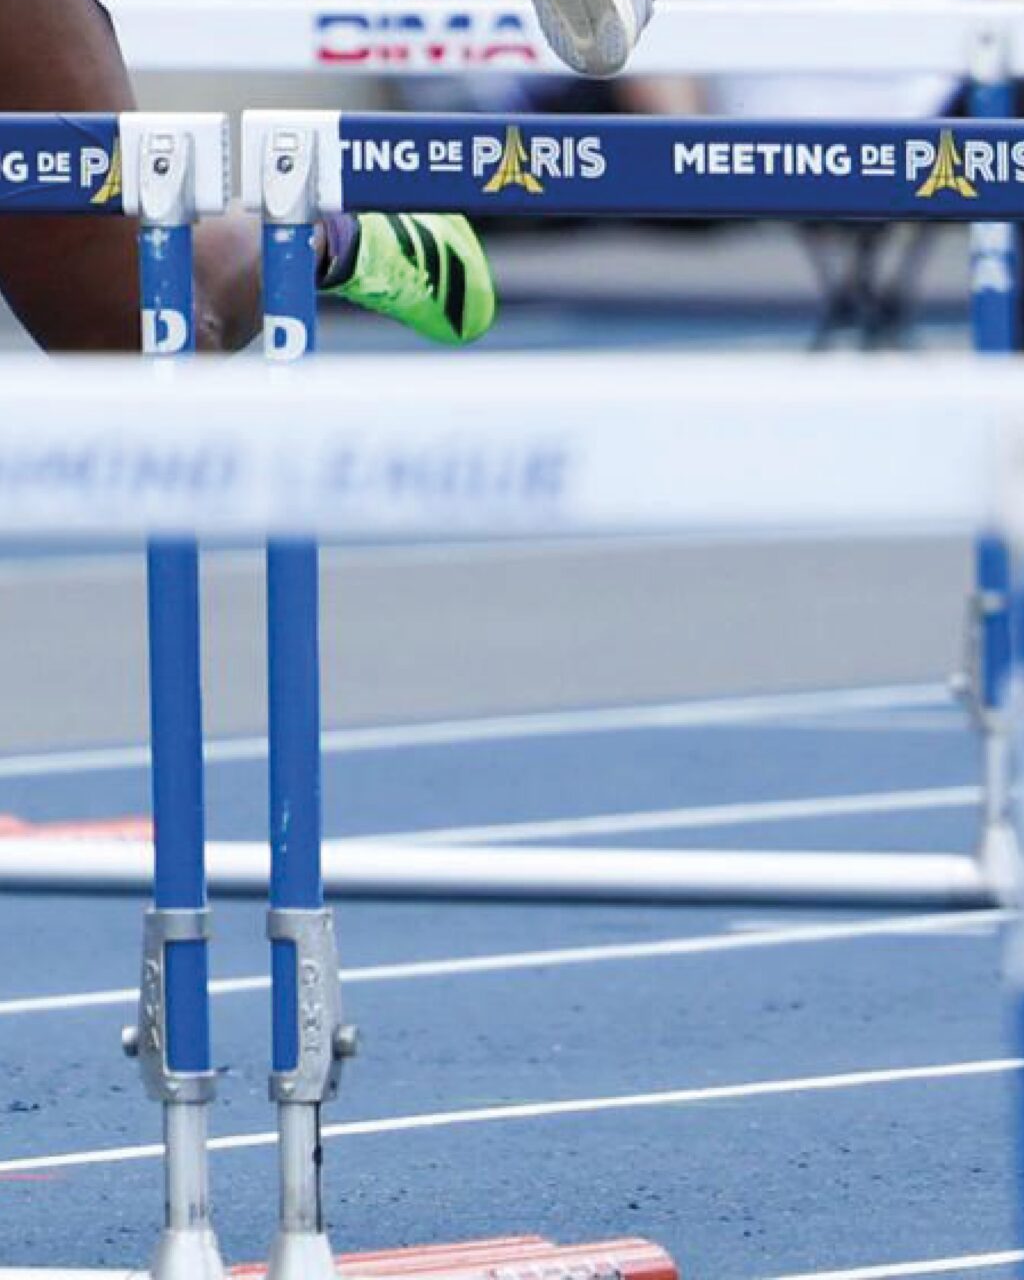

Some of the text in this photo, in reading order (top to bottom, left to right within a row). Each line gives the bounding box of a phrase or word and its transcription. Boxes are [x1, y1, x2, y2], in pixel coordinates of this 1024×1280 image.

[316, 12, 538, 62] DIMA
[37, 152, 71, 172] DE
[428, 141, 463, 163] DE
[472, 125, 606, 192] PARIS
[673, 142, 851, 175] MEETING
[861, 144, 895, 166] DE
